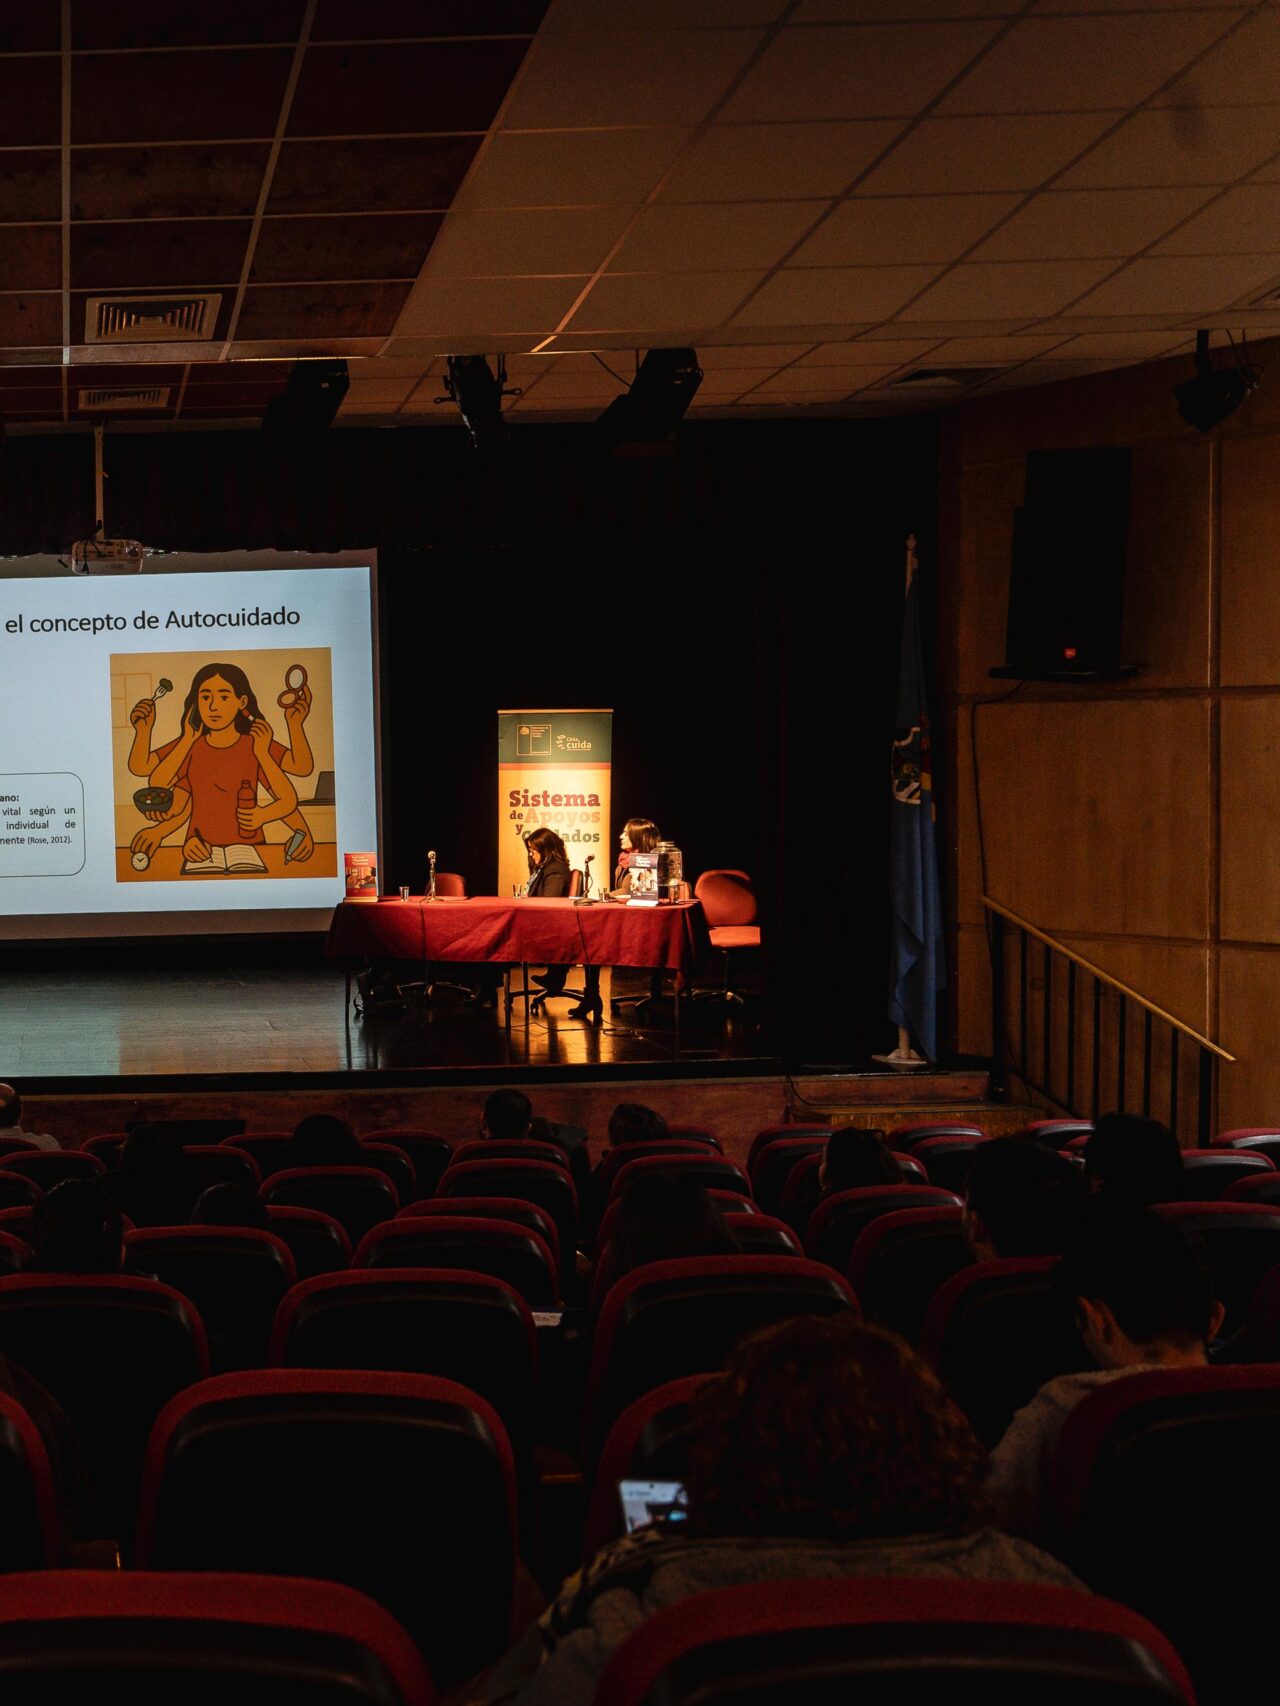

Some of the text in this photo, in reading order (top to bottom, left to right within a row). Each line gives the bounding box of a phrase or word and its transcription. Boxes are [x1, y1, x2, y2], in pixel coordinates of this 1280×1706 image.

[5, 614, 23, 633] el
[29, 612, 127, 635] concepto
[133, 610, 159, 630] de
[165, 606, 301, 629] Autocuidado
[566, 740, 592, 749] cuida
[509, 789, 601, 808] Sistema
[2, 807, 21, 816] vital
[29, 806, 56, 817] según
[509, 808, 601, 828] de Apoyos
[6, 820, 49, 830] individual
[64, 820, 76, 828] de
[515, 824, 524, 835] y
[27, 836, 49, 845] (Rose,
[50, 836, 72, 844] 2012).
